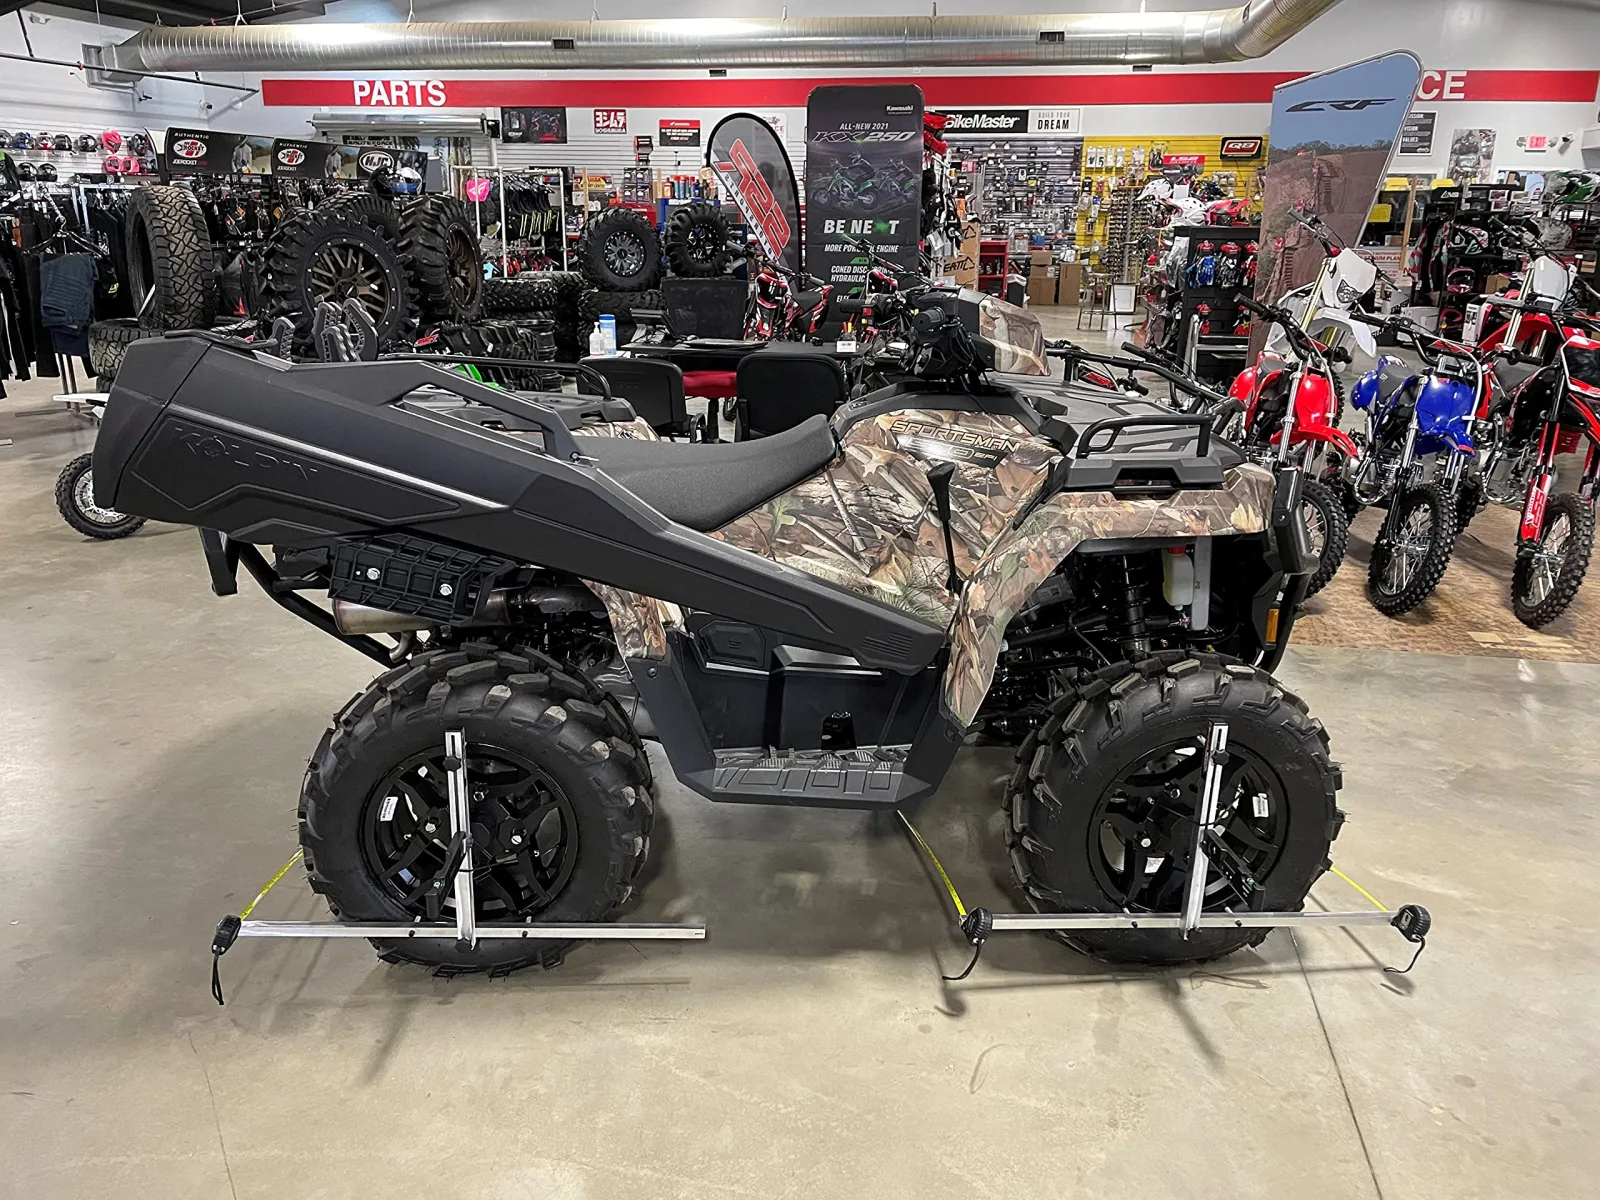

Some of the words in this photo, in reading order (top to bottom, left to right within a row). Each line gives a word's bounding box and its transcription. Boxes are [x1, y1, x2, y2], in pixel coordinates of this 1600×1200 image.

[353, 80, 446, 106] PARTS
[1285, 98, 1396, 113] CRF
[872, 122, 889, 130] 2021
[945, 113, 1018, 129] BikeMaster
[1037, 119, 1070, 130] DREAM
[174, 132, 210, 140] AUTHENTIC
[365, 155, 390, 168] HJC
[823, 219, 846, 234] BE
[824, 244, 842, 252] MORE
[876, 245, 899, 253] ENGINE
[831, 265, 852, 274] CONED
[830, 274, 866, 283] HYDRAULIC
[890, 420, 1019, 454] SPORTSMAN
